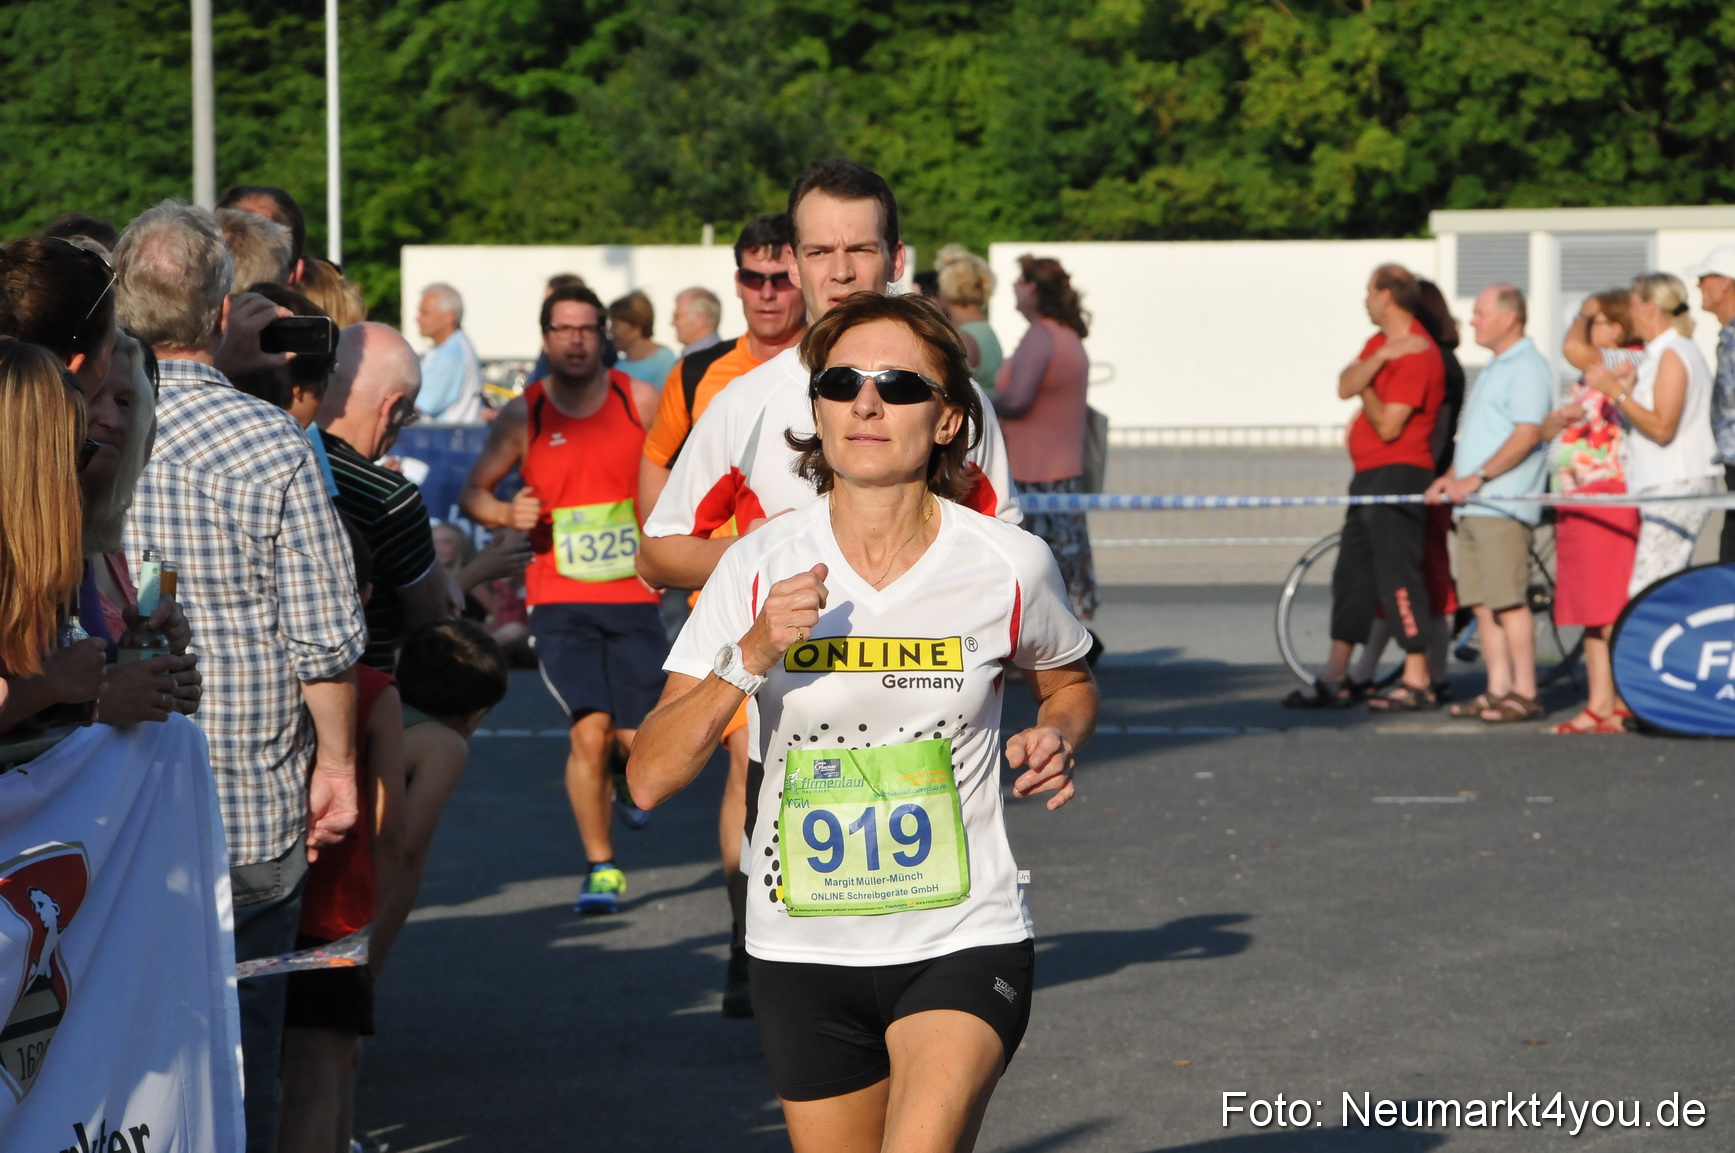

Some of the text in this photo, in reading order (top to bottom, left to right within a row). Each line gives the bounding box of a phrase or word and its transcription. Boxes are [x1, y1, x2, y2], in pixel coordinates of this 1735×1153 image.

[560, 527, 637, 564] 1325
[793, 641, 948, 667] ONLINE
[882, 674, 964, 692] Germany
[801, 776, 866, 789] firmenlauf
[802, 803, 932, 873] 919
[824, 871, 924, 888] Margit Müller-Münch
[811, 884, 939, 901] ONLINE Schreibgeräte GmbH
